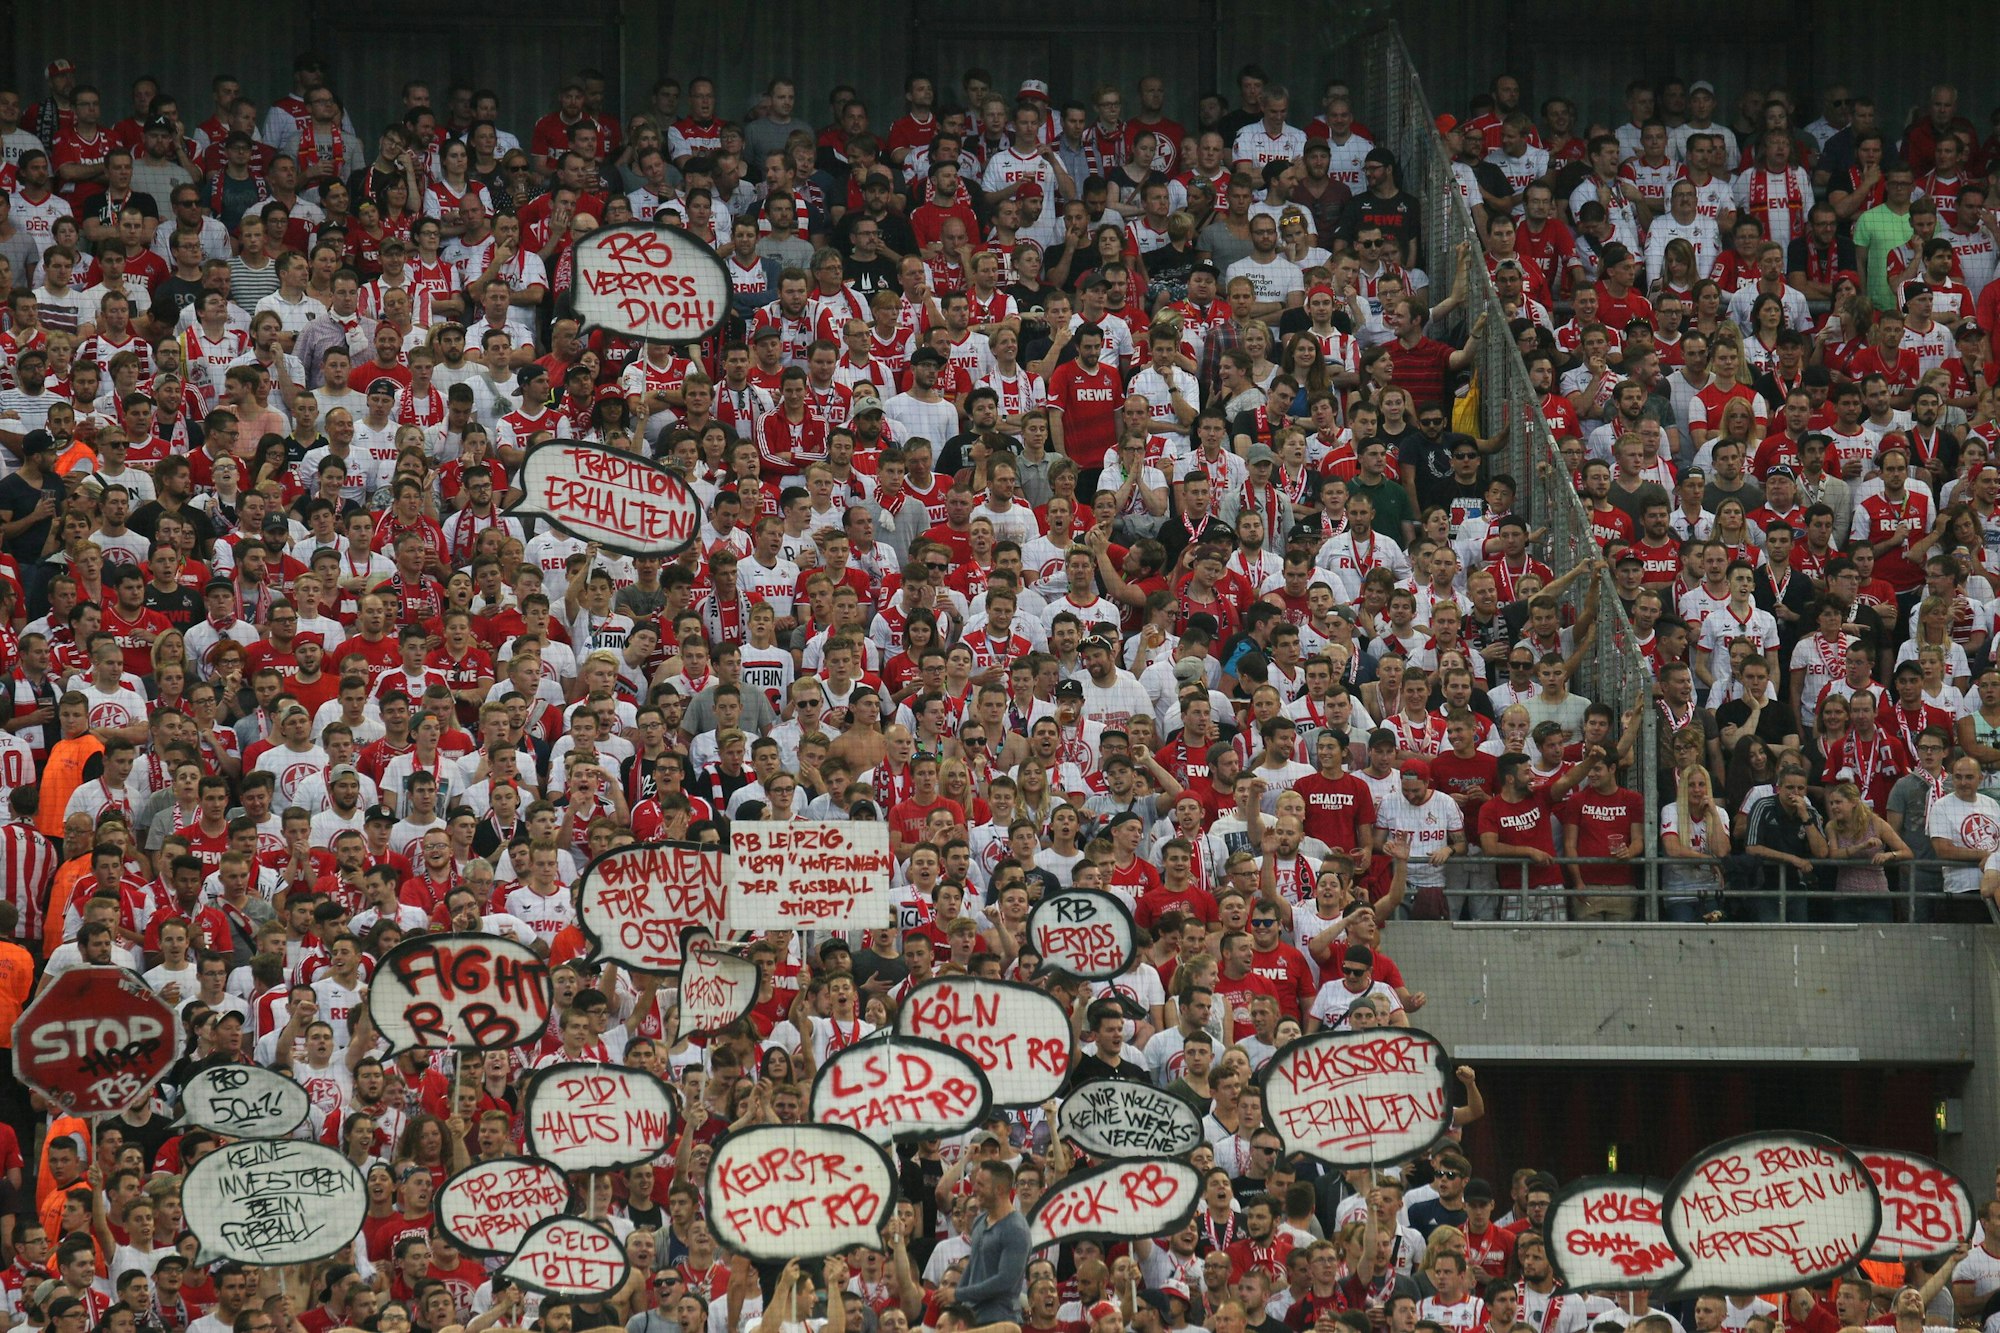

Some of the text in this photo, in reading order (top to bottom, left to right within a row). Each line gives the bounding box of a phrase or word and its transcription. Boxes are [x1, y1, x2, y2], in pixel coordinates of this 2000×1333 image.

[1330, 172, 1359, 183] EWE
[598, 233, 672, 271] RB
[121, 273, 149, 287] EWE
[582, 270, 695, 296] VERPISS
[618, 299, 715, 331] DICH!
[1077, 389, 1112, 401] REWE
[564, 450, 685, 505] TRADITION
[544, 476, 694, 540] ERHALTEN!
[755, 585, 793, 596] REWE
[1309, 793, 1354, 806] CHAOTIX
[1582, 804, 1627, 817] CHAOTIX
[733, 832, 761, 849] RB
[599, 850, 723, 886] BANANEN
[738, 877, 873, 895] DER FUSSBALL
[665, 886, 728, 922] DEN
[1051, 898, 1097, 923] RB
[1037, 924, 1115, 958] VERPISS
[390, 944, 549, 1022] FIGHT
[911, 984, 1000, 1034] KÖLN
[31, 1016, 163, 1064] STOP
[1027, 1038, 1069, 1076] RB
[557, 1075, 631, 1102] DIDI
[926, 1078, 977, 1116] RB
[535, 1111, 619, 1144] HALTS
[1279, 1088, 1446, 1138] ERHALTEN!
[227, 1141, 301, 1170] KEINE
[219, 1167, 355, 1198] INVESTOREN
[451, 1165, 553, 1199] TOD DEM
[1120, 1164, 1179, 1212] RB
[1696, 1155, 1750, 1192] RB
[724, 1184, 879, 1242] FICKT RB
[1679, 1173, 1824, 1228] MENSCHEN
[547, 1226, 609, 1251] GELD
[1689, 1221, 1805, 1263] VERPISST
